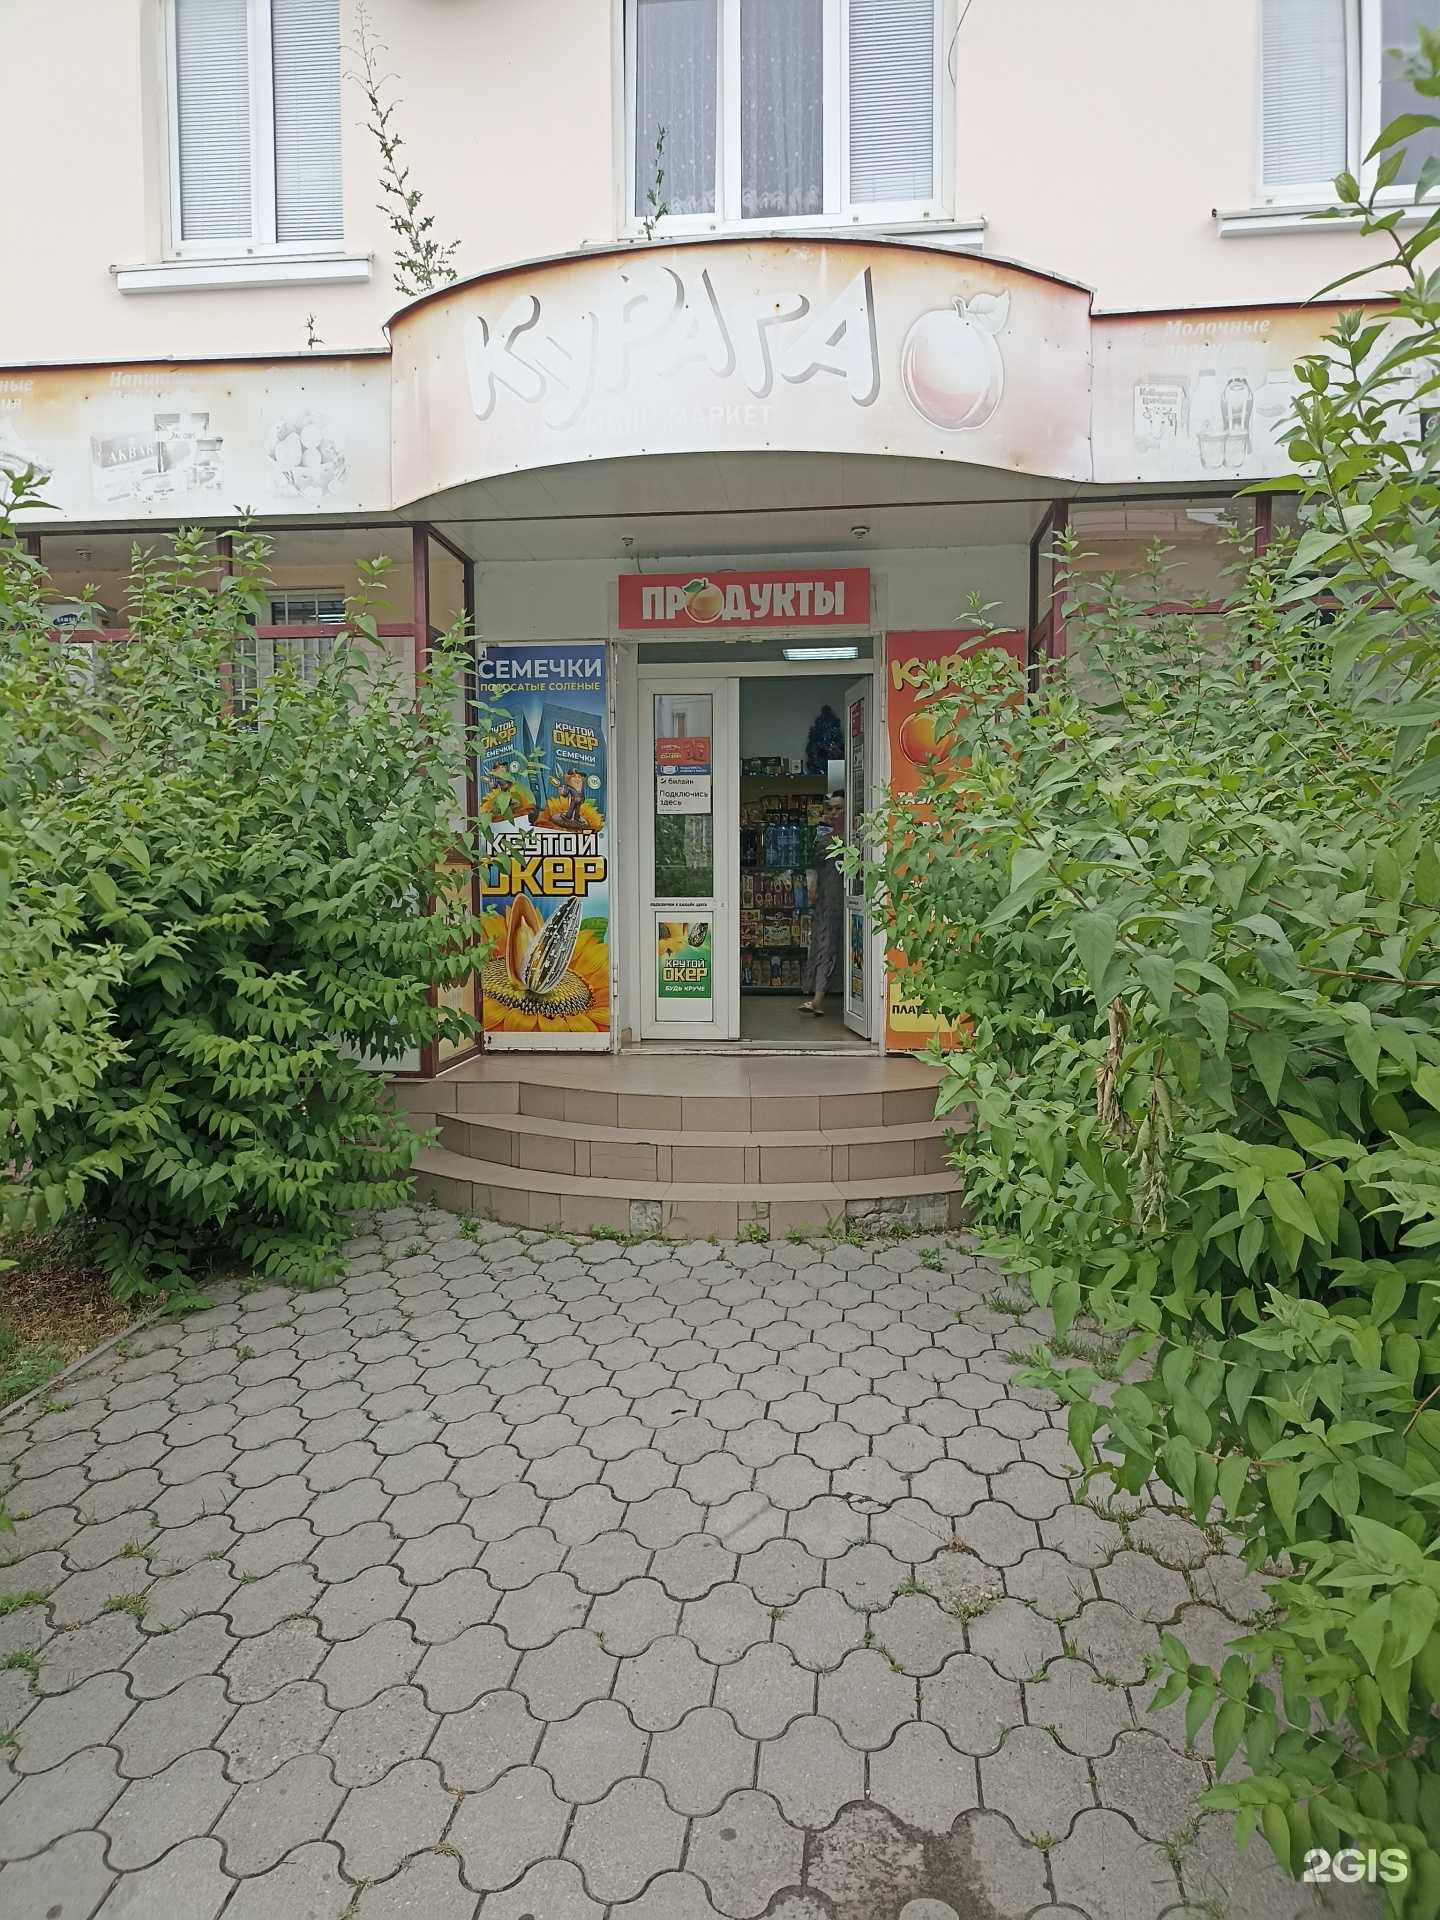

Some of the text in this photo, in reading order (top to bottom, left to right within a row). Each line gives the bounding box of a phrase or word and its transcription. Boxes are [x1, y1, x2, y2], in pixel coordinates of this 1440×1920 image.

[642, 579, 845, 623] ПРОДУКТЫ
[479, 658, 602, 679] СЕМЕЧКИ
[549, 682, 601, 691] СОЛЕНЫЕ
[555, 722, 595, 738] КРУТОЙ
[486, 744, 514, 758] ЕМЕЧКИ
[556, 749, 596, 763] СЕМЕЧКИ
[660, 790, 709, 798] Подключись
